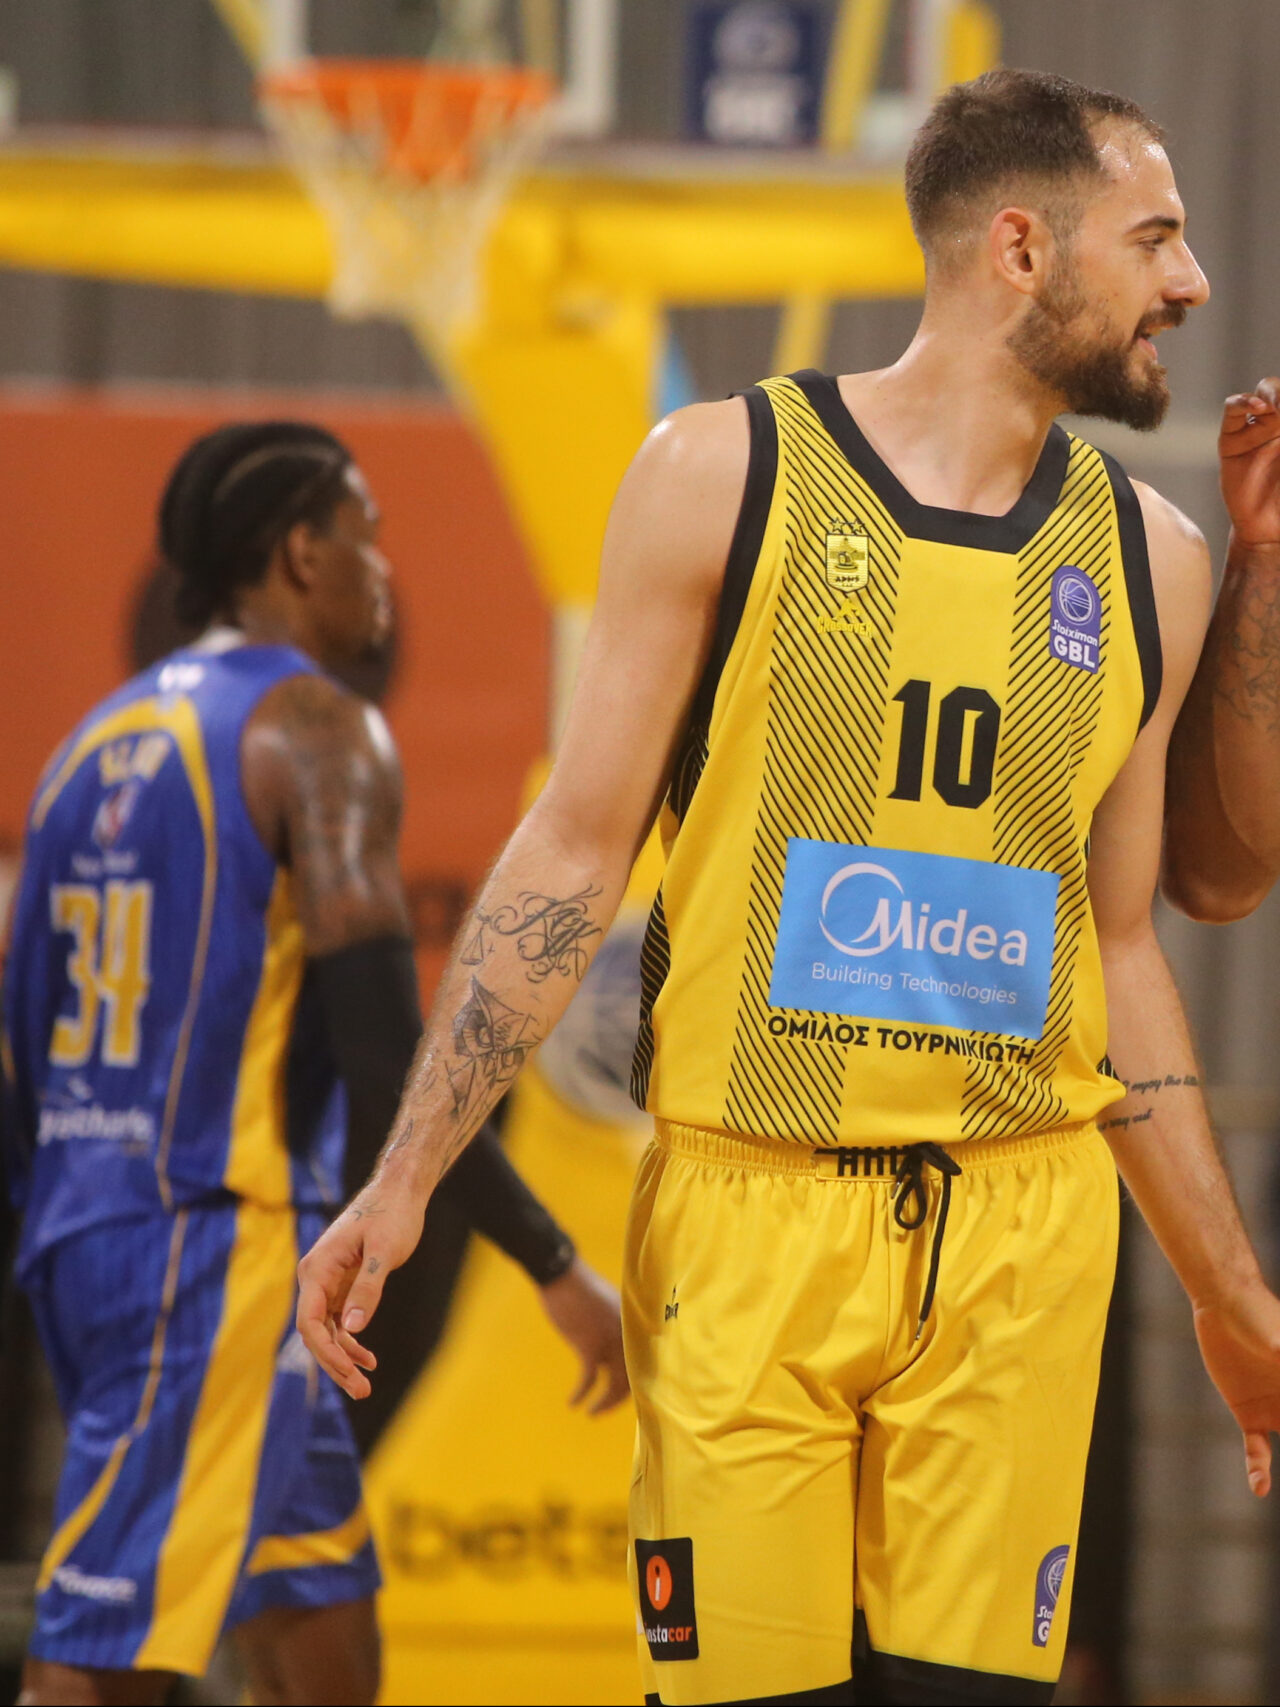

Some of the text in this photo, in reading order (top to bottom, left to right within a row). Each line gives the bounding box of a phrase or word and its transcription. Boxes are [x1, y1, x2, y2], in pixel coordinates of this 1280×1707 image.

[1052, 619, 1098, 647] Stoiximan
[1053, 634, 1096, 669] GBL
[886, 678, 1002, 810] 10
[850, 897, 1029, 967] Midea
[48, 878, 155, 1070] 34
[811, 962, 1018, 1005] Building Technologies
[767, 1015, 869, 1046] ΟΜΙΛΟΣ
